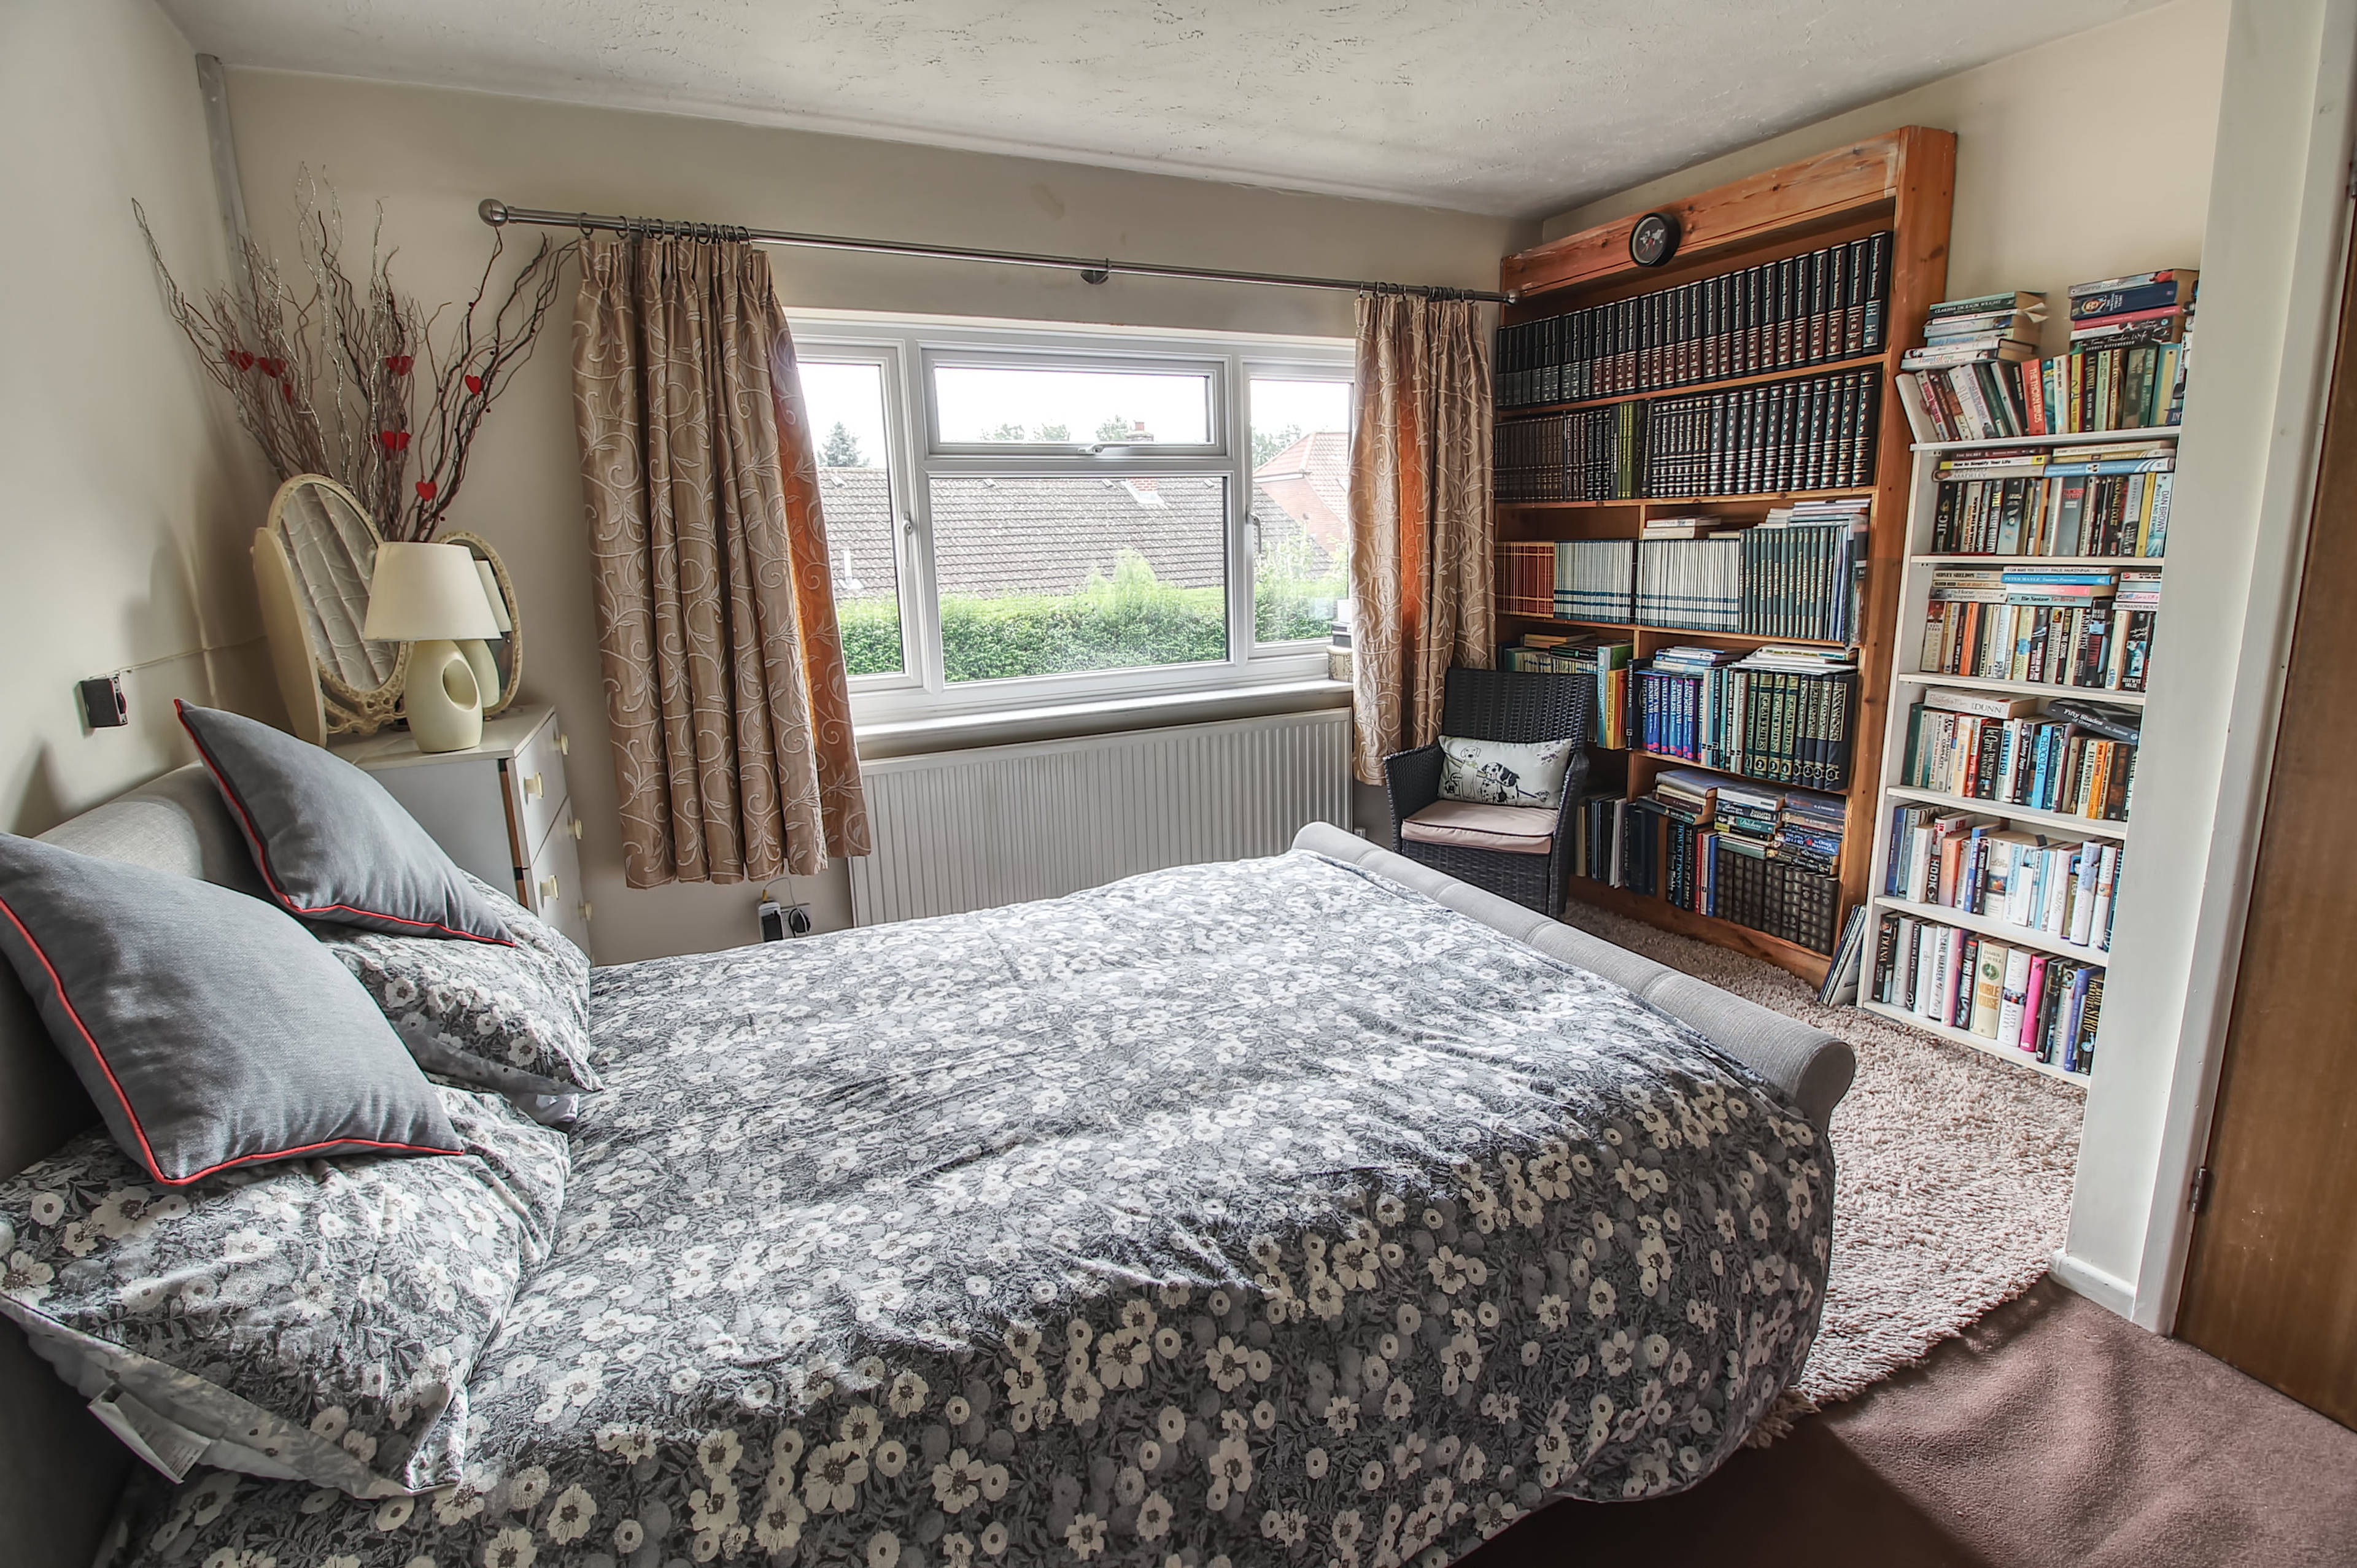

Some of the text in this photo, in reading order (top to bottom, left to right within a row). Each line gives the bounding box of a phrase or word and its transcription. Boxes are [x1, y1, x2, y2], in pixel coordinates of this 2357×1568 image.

[2156, 491, 2169, 533] DAN BROWN
[2037, 735, 2048, 776] CHOCOLAT
[1879, 936, 1890, 962] DIANA
